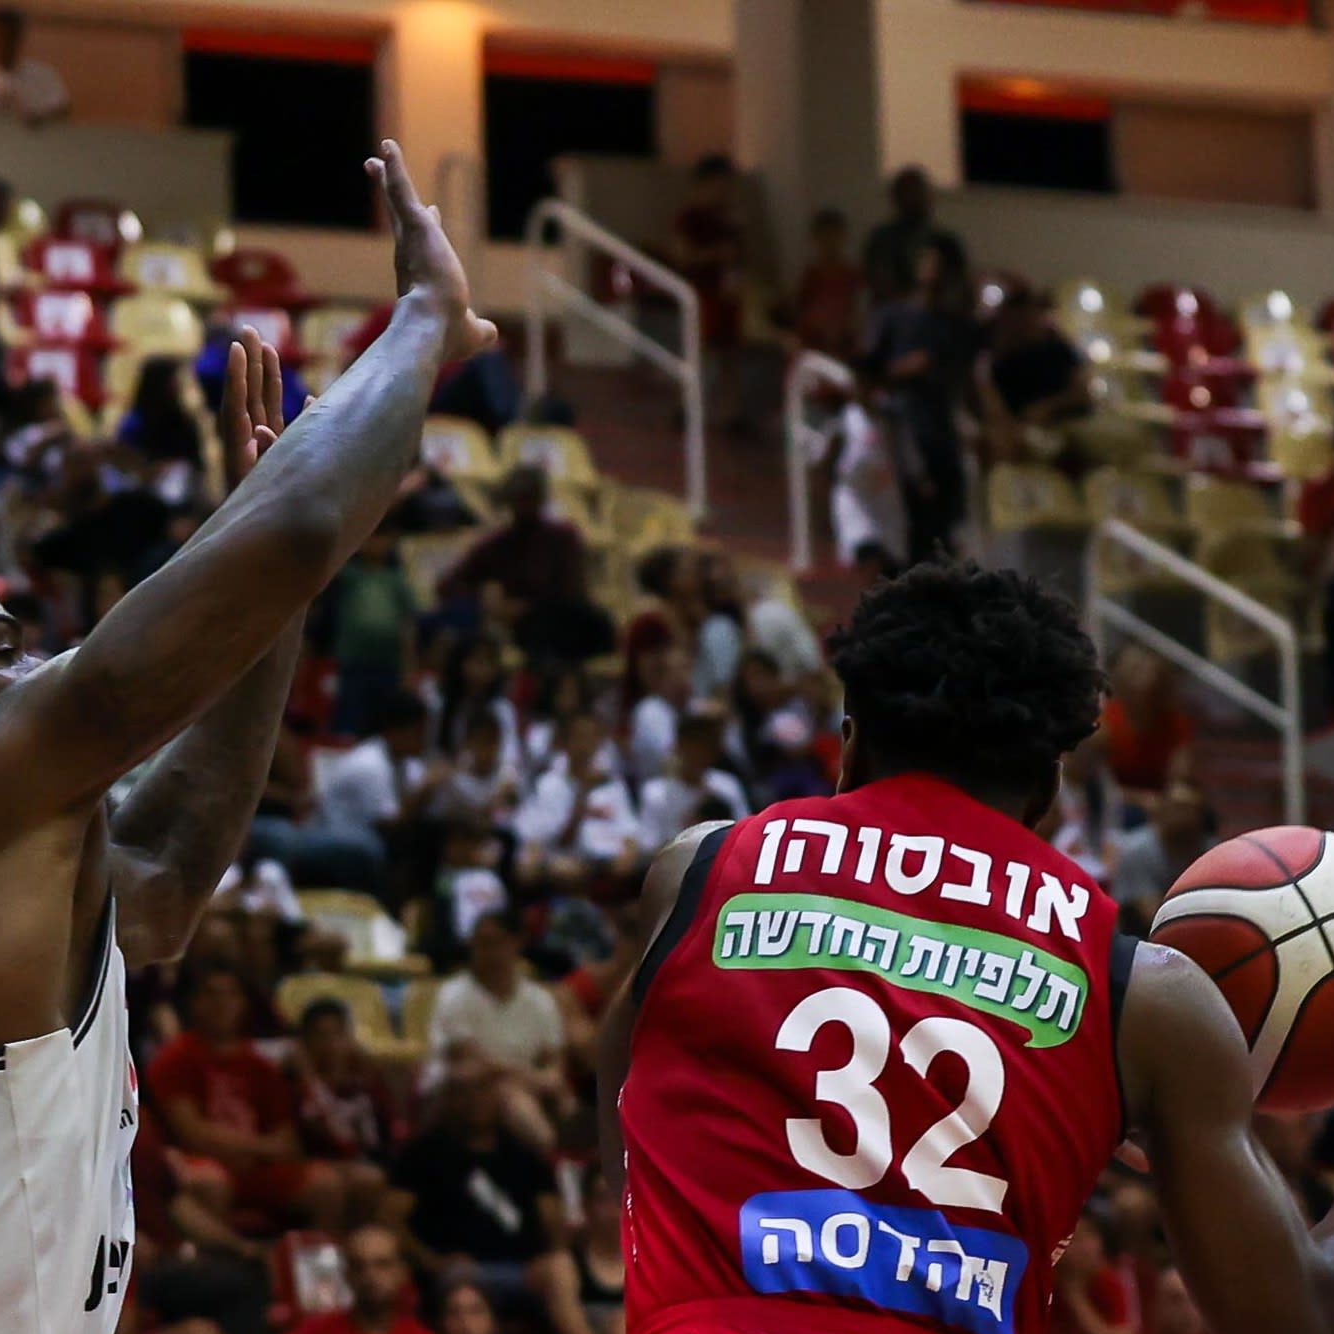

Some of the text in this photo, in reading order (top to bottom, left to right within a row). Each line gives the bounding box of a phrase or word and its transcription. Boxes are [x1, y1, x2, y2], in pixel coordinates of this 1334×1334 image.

[753, 818, 1091, 943] אובסוהן
[720, 909, 1081, 1031] תלפיות החדשה
[775, 986, 1009, 1215] 32
